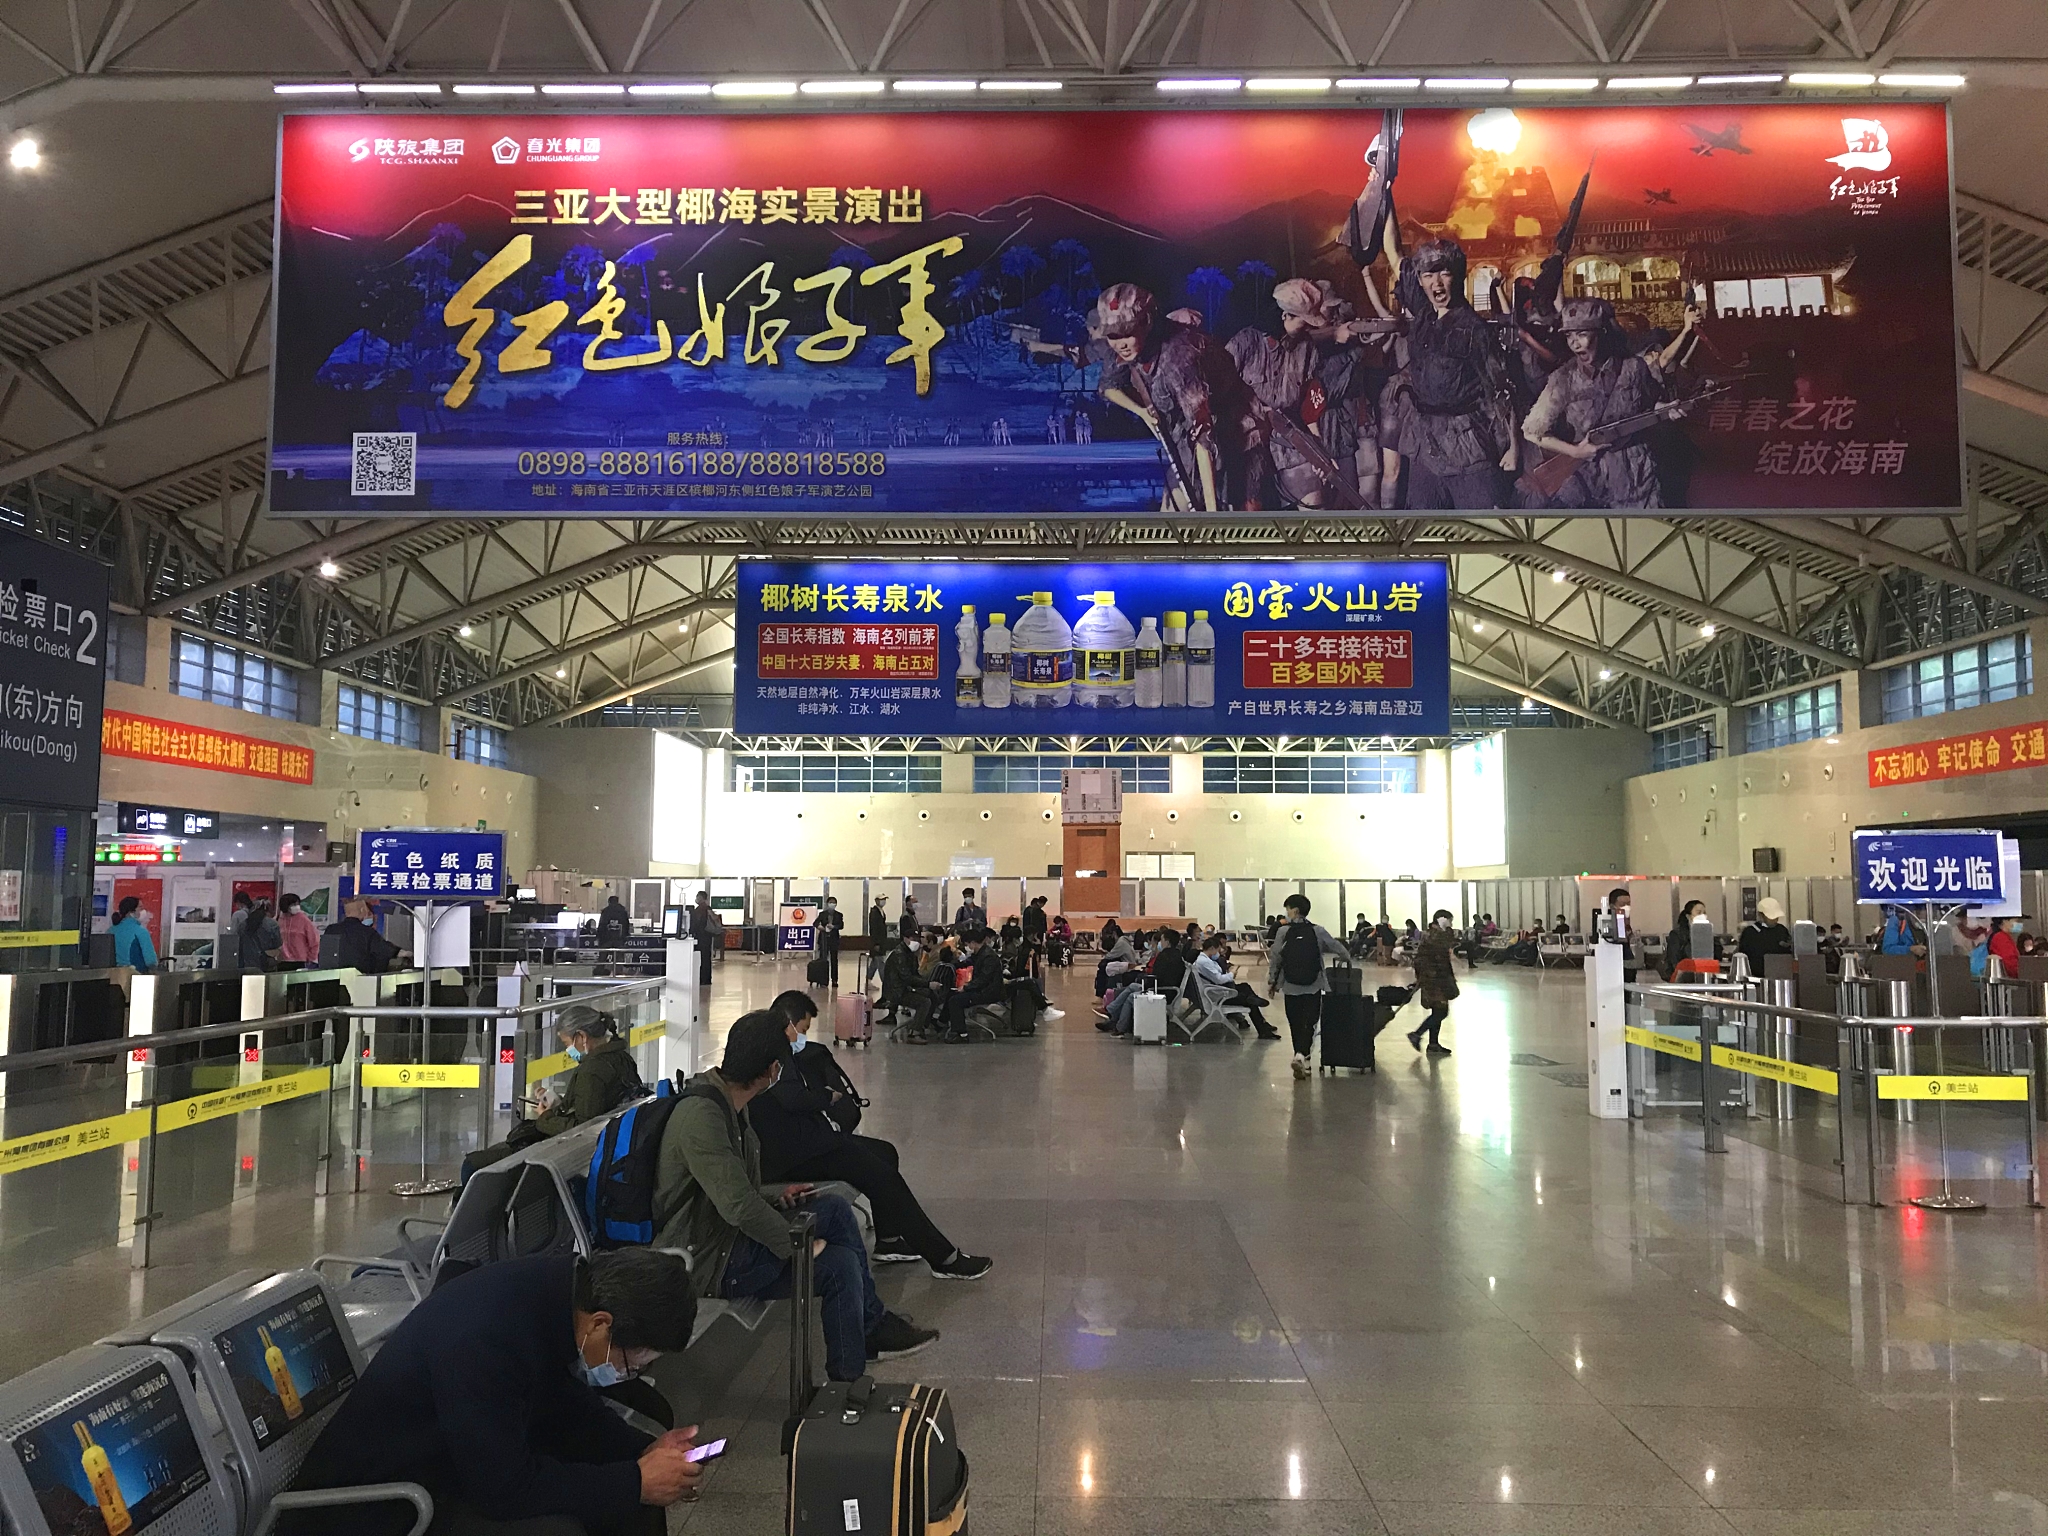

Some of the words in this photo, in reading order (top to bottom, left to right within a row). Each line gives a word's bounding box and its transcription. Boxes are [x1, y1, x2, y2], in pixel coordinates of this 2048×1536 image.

[374, 138, 464, 156] 陕旅集团
[526, 137, 601, 153] 春光集团
[1829, 175, 1900, 200] 红色娘子军
[510, 185, 923, 225] 三亚大型椰海实景演出
[443, 233, 964, 409] 红色娘子军
[1707, 396, 1857, 432] 青春之花
[518, 451, 886, 478] 0898-88816188/88818588
[1754, 440, 1909, 475] 绽放海南
[760, 583, 944, 613] 椰树长寿泉水
[1223, 580, 1293, 620] 国宝
[1302, 582, 1423, 613] 火山岩
[34, 635, 71, 660] Check
[76, 609, 98, 666] 2
[761, 627, 846, 646] 全国长寿指数
[852, 626, 936, 646] 海南名列前茅
[1247, 636, 1408, 660] 二十多年接待过
[1270, 662, 1385, 685] 百多国外宾
[0, 682, 83, 729] (东)方向
[1228, 700, 1423, 716] 产自世界长寿之乡海南岛澄迈
[1874, 750, 1930, 782] 不忘初心
[1937, 736, 2000, 774] 牢记使命
[370, 872, 494, 890] 车票检票通道
[1867, 855, 1994, 892] 欢迎光临
[788, 928, 810, 939] 出口
[276, 1081, 298, 1096] 美兰站
[415, 1071, 446, 1081] 美兰站
[1946, 1083, 1979, 1094] 美兰站
[77, 1127, 111, 1147] 美兰站
